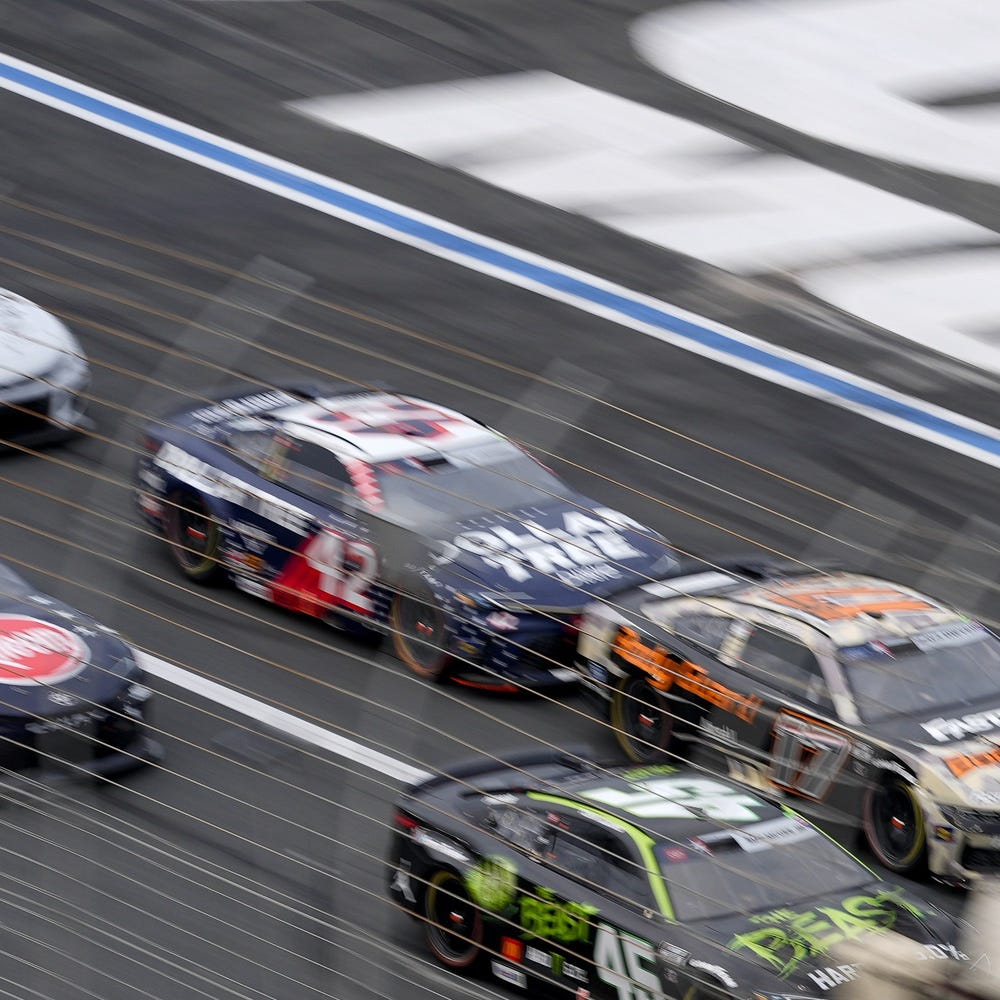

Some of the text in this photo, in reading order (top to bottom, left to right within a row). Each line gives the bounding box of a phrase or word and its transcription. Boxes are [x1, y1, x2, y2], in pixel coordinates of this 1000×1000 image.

[304, 527, 379, 613] 42
[768, 709, 852, 804] 17
[807, 963, 864, 991] HAR
